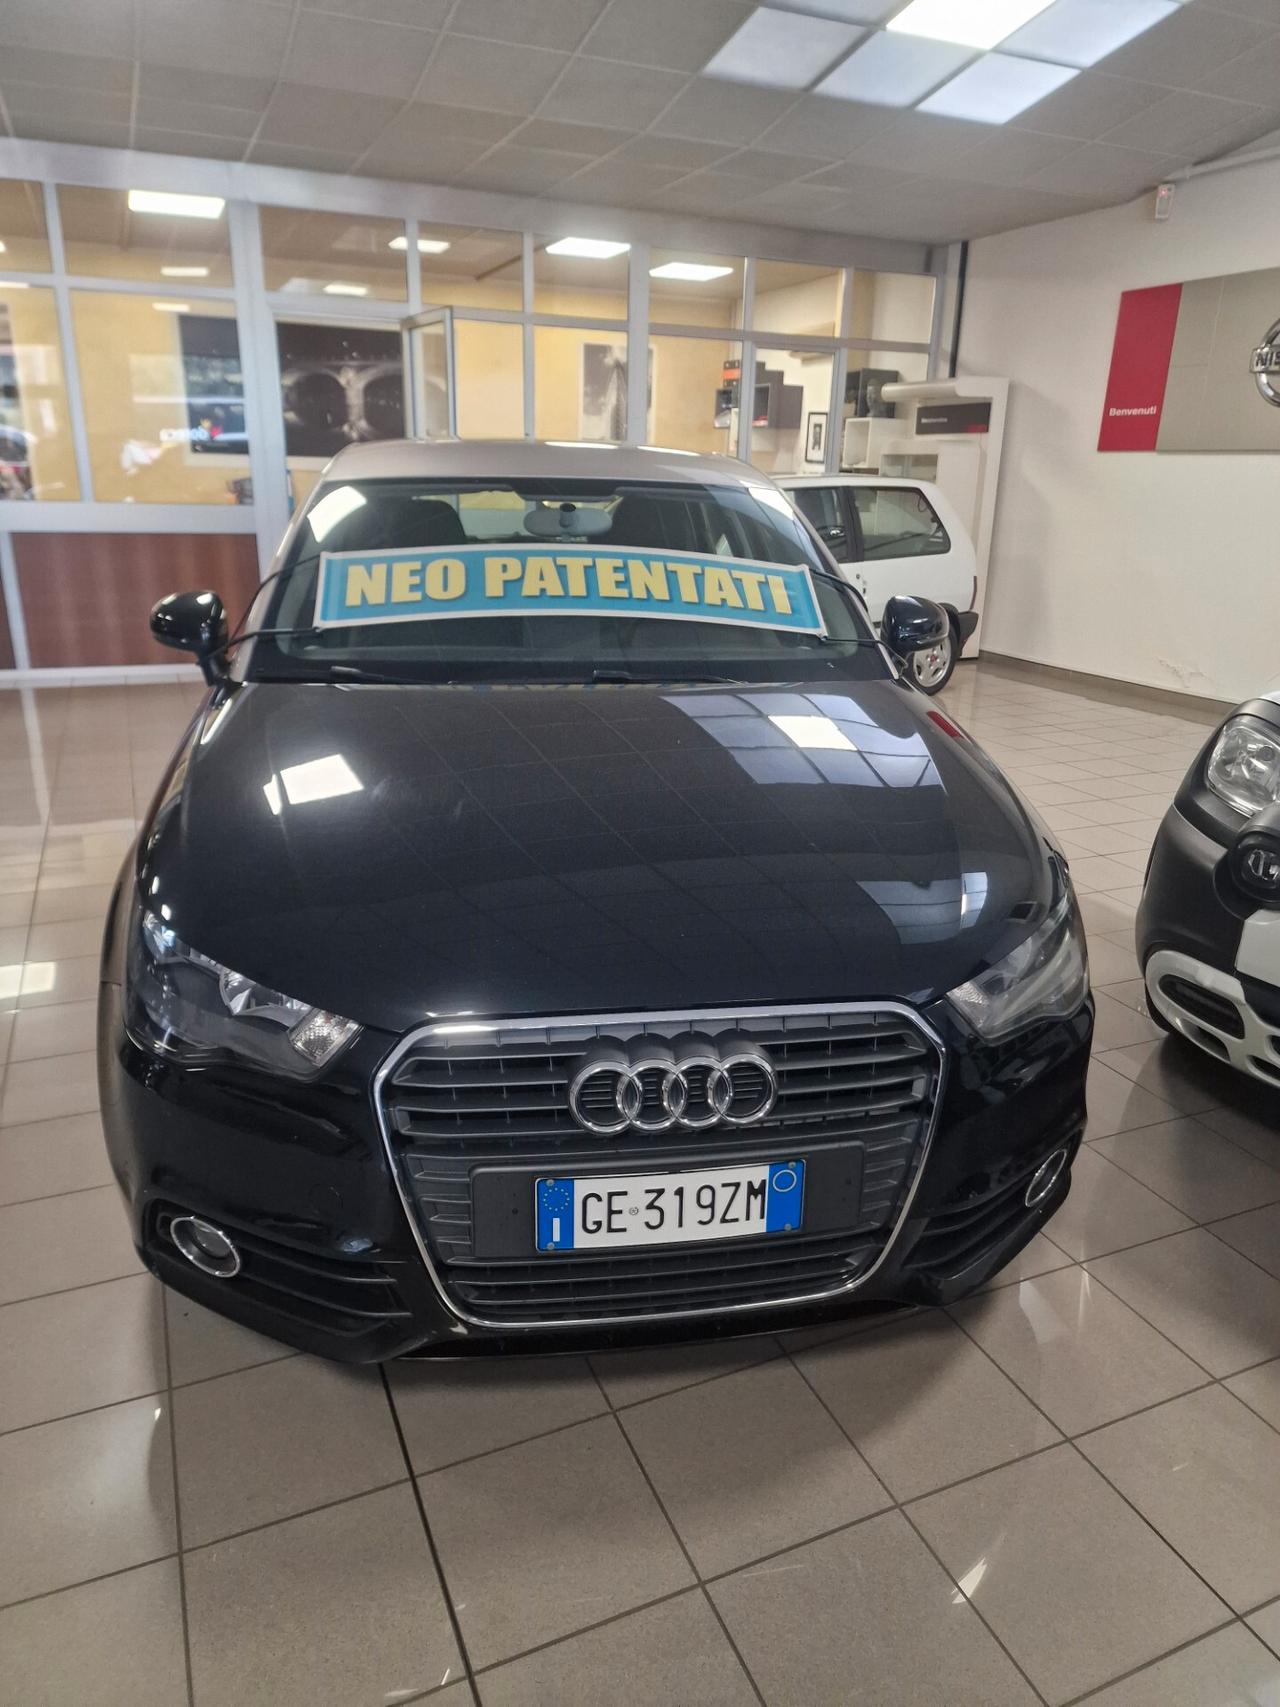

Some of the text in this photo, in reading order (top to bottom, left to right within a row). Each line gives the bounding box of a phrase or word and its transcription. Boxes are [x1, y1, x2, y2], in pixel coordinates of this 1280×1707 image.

[1109, 406, 1157, 417] Benvenuti
[345, 557, 792, 614] NEO PATENTATI
